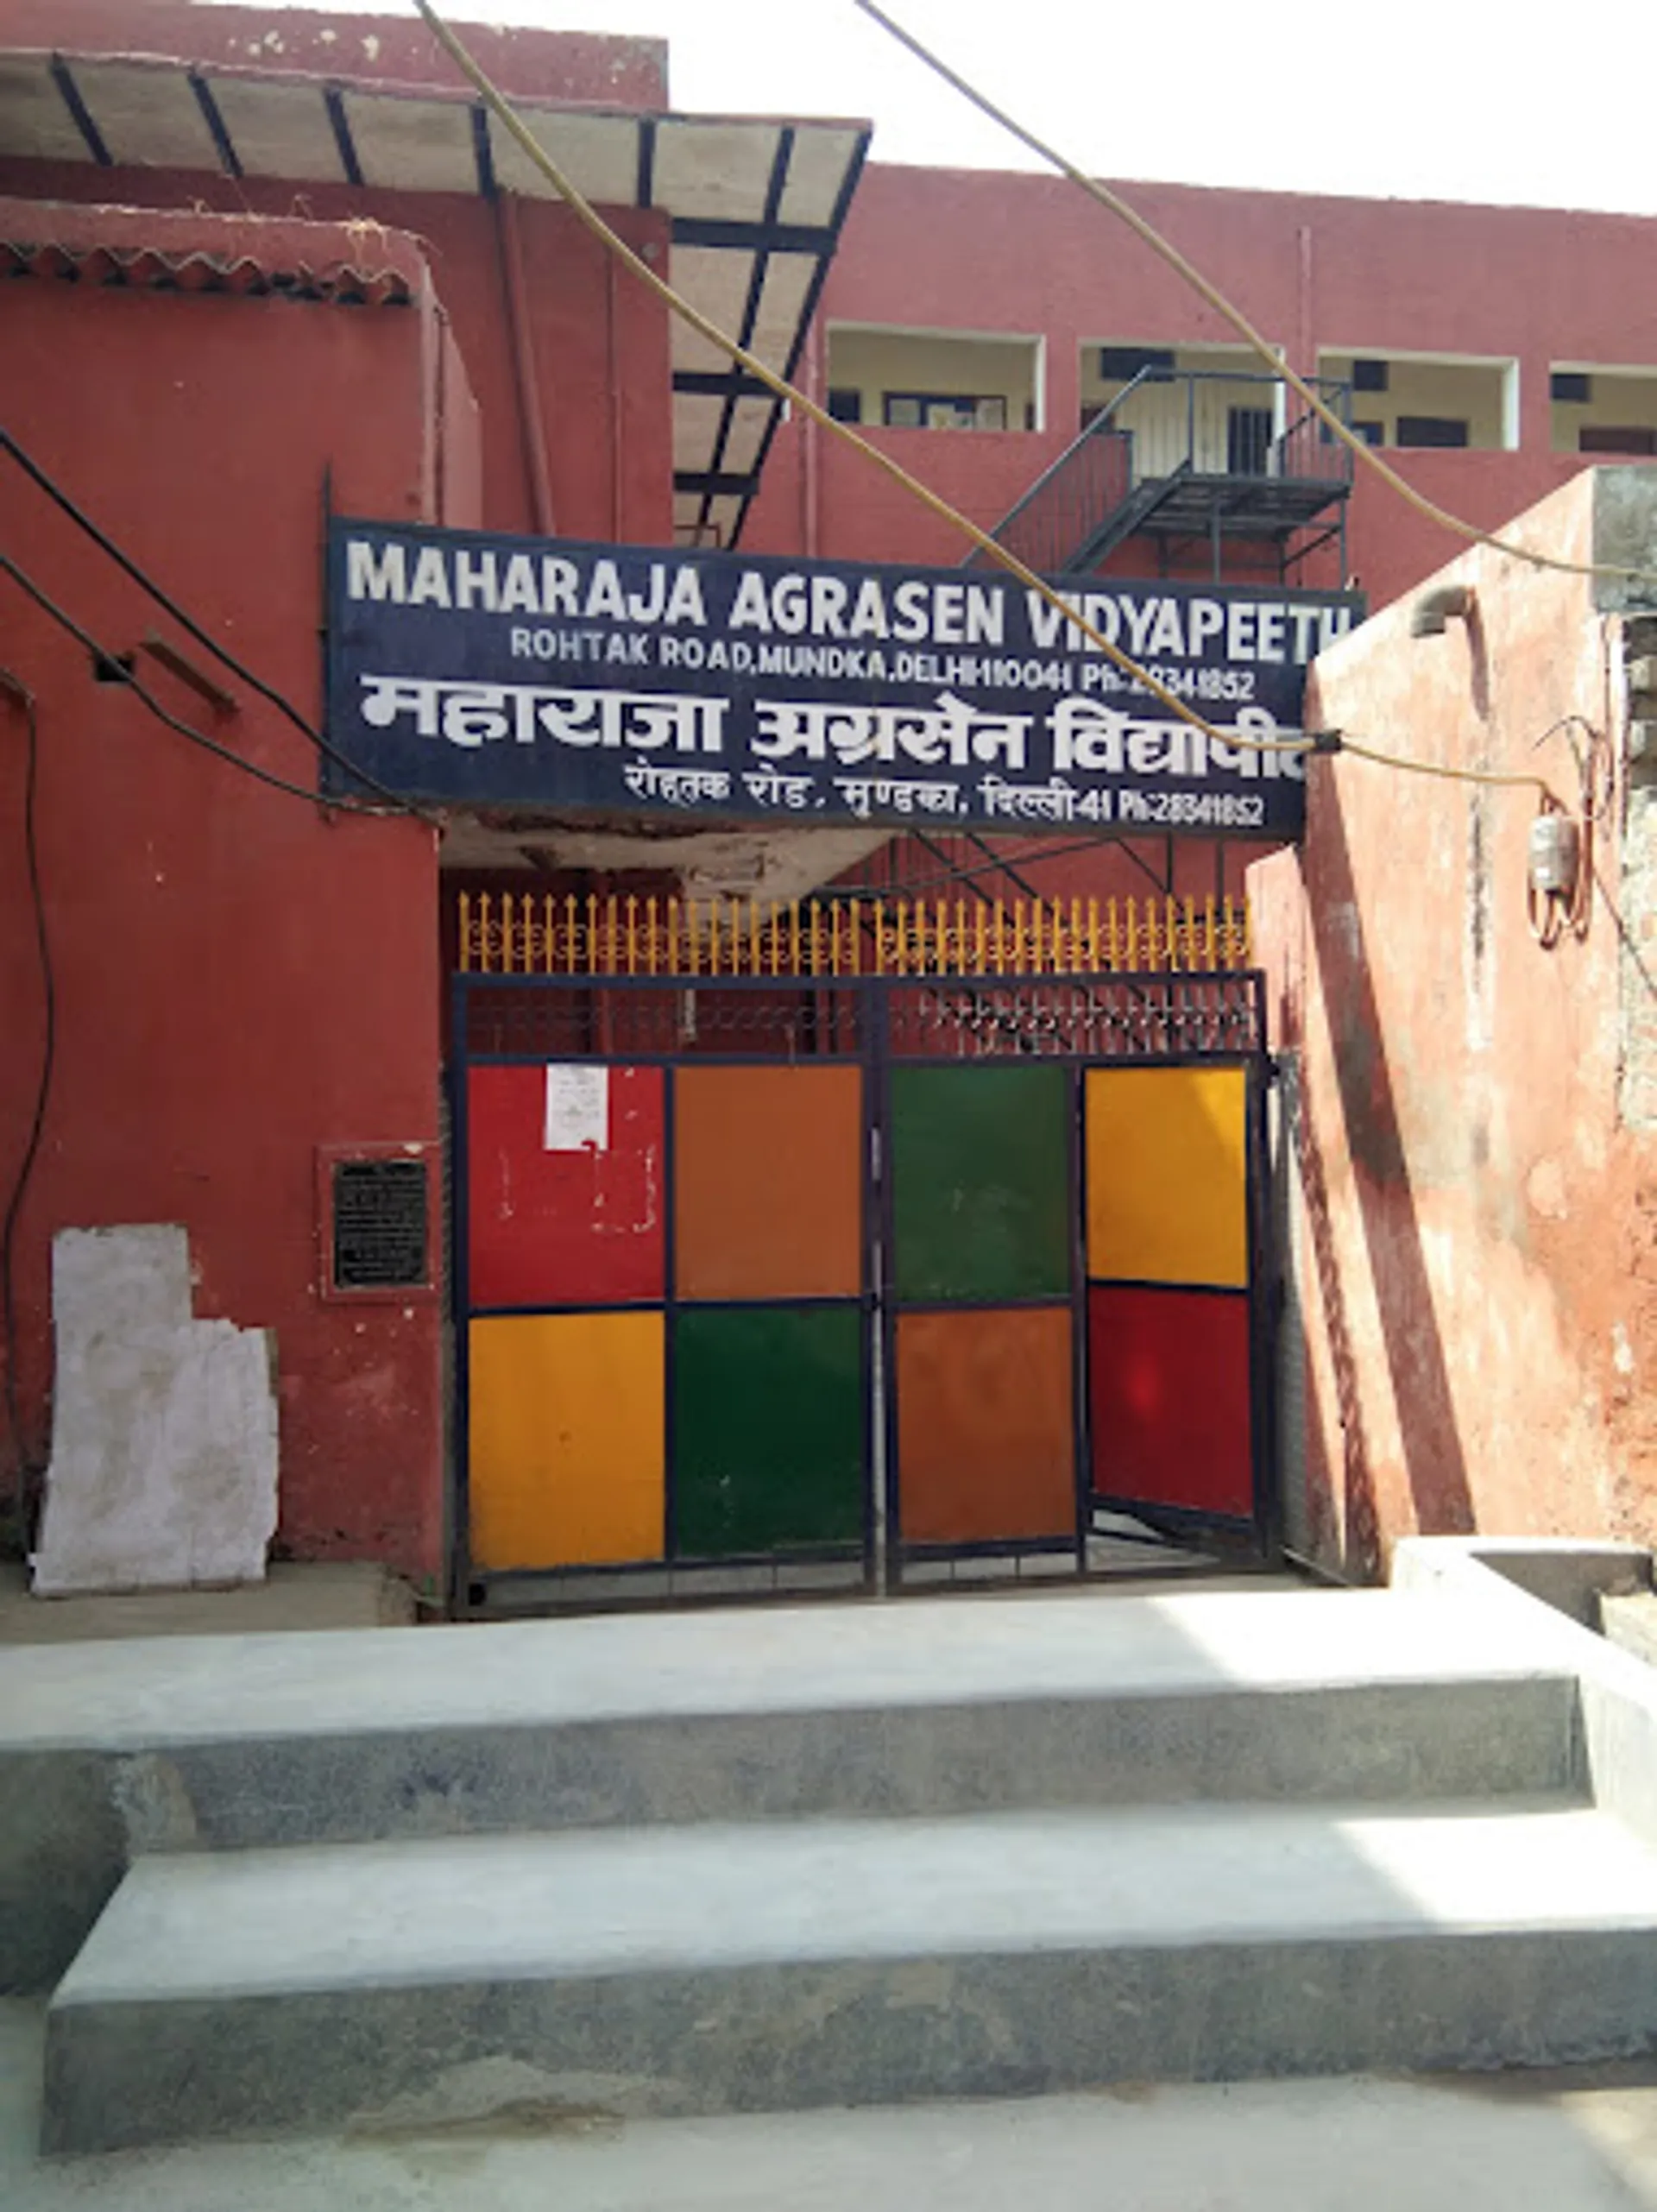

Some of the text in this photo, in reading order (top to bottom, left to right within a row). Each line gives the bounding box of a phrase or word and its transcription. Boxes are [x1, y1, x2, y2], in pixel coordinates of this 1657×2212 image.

[346, 540, 707, 627] MAHARAJA
[729, 570, 1004, 647] AGRASEN
[510, 627, 649, 665] ROHTAK
[361, 674, 730, 753] महाराजा
[750, 691, 1033, 782] अग्रसेन
[623, 755, 730, 808] रोहतक
